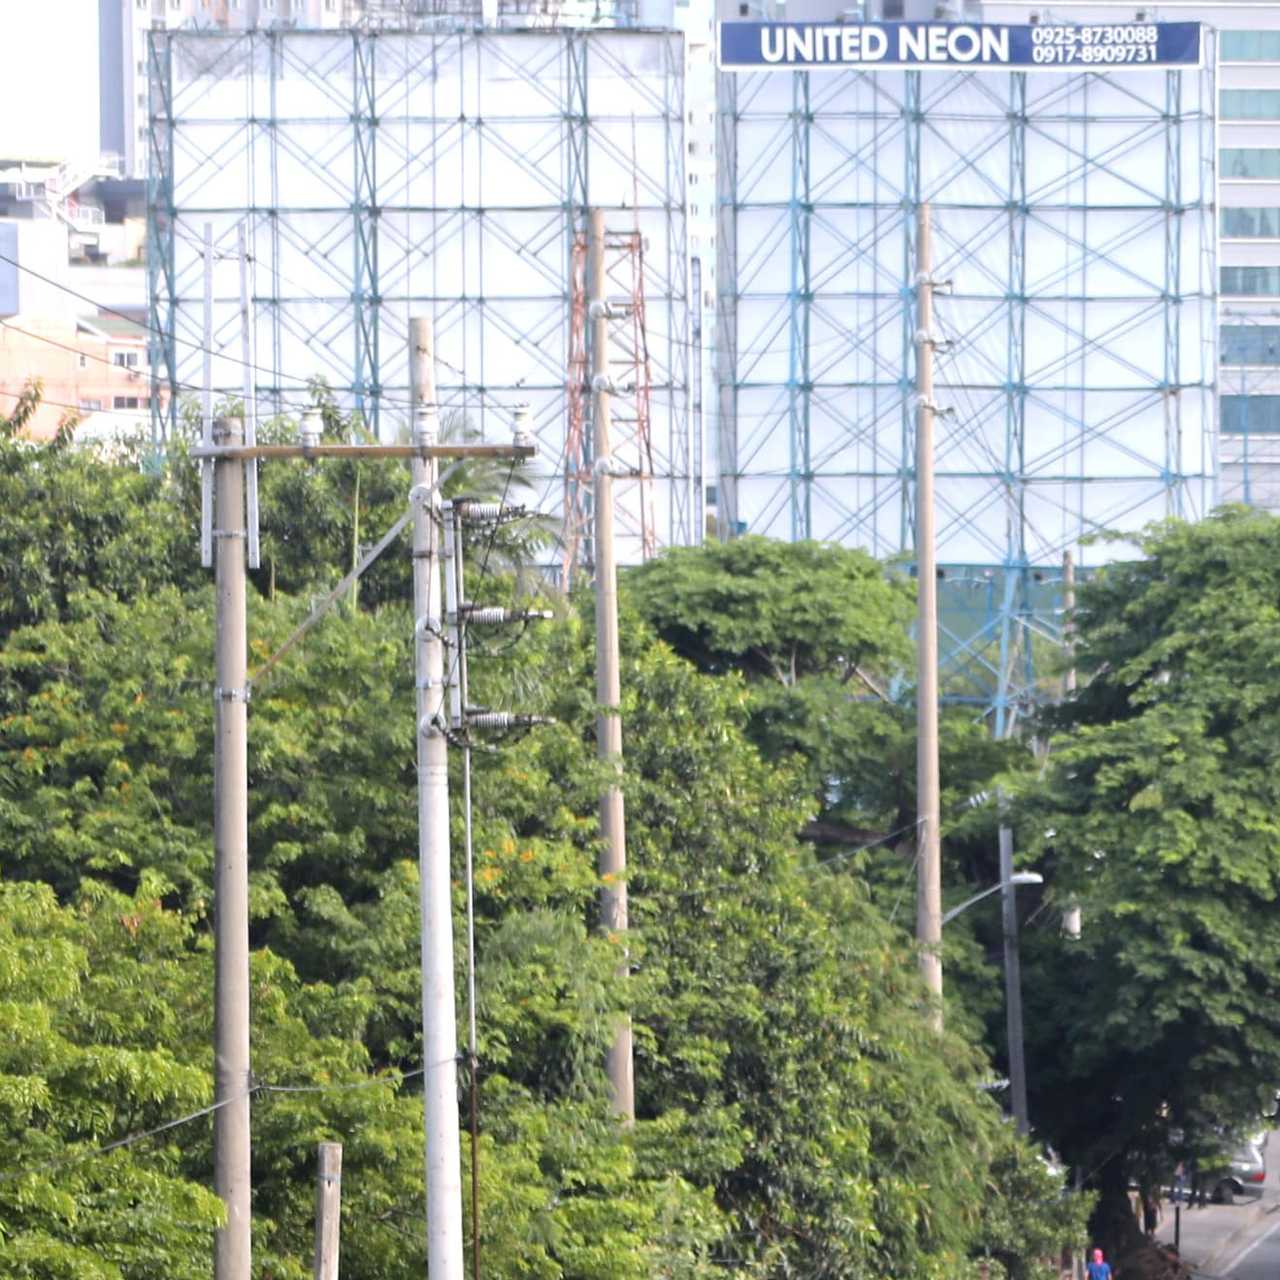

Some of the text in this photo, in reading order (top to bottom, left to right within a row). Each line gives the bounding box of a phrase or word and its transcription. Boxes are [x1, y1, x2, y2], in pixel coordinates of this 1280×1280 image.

[760, 26, 1010, 62] UNITED NEON
[1032, 26, 1157, 45] 0925-8730088
[1032, 44, 1157, 63] 0917-8909731
